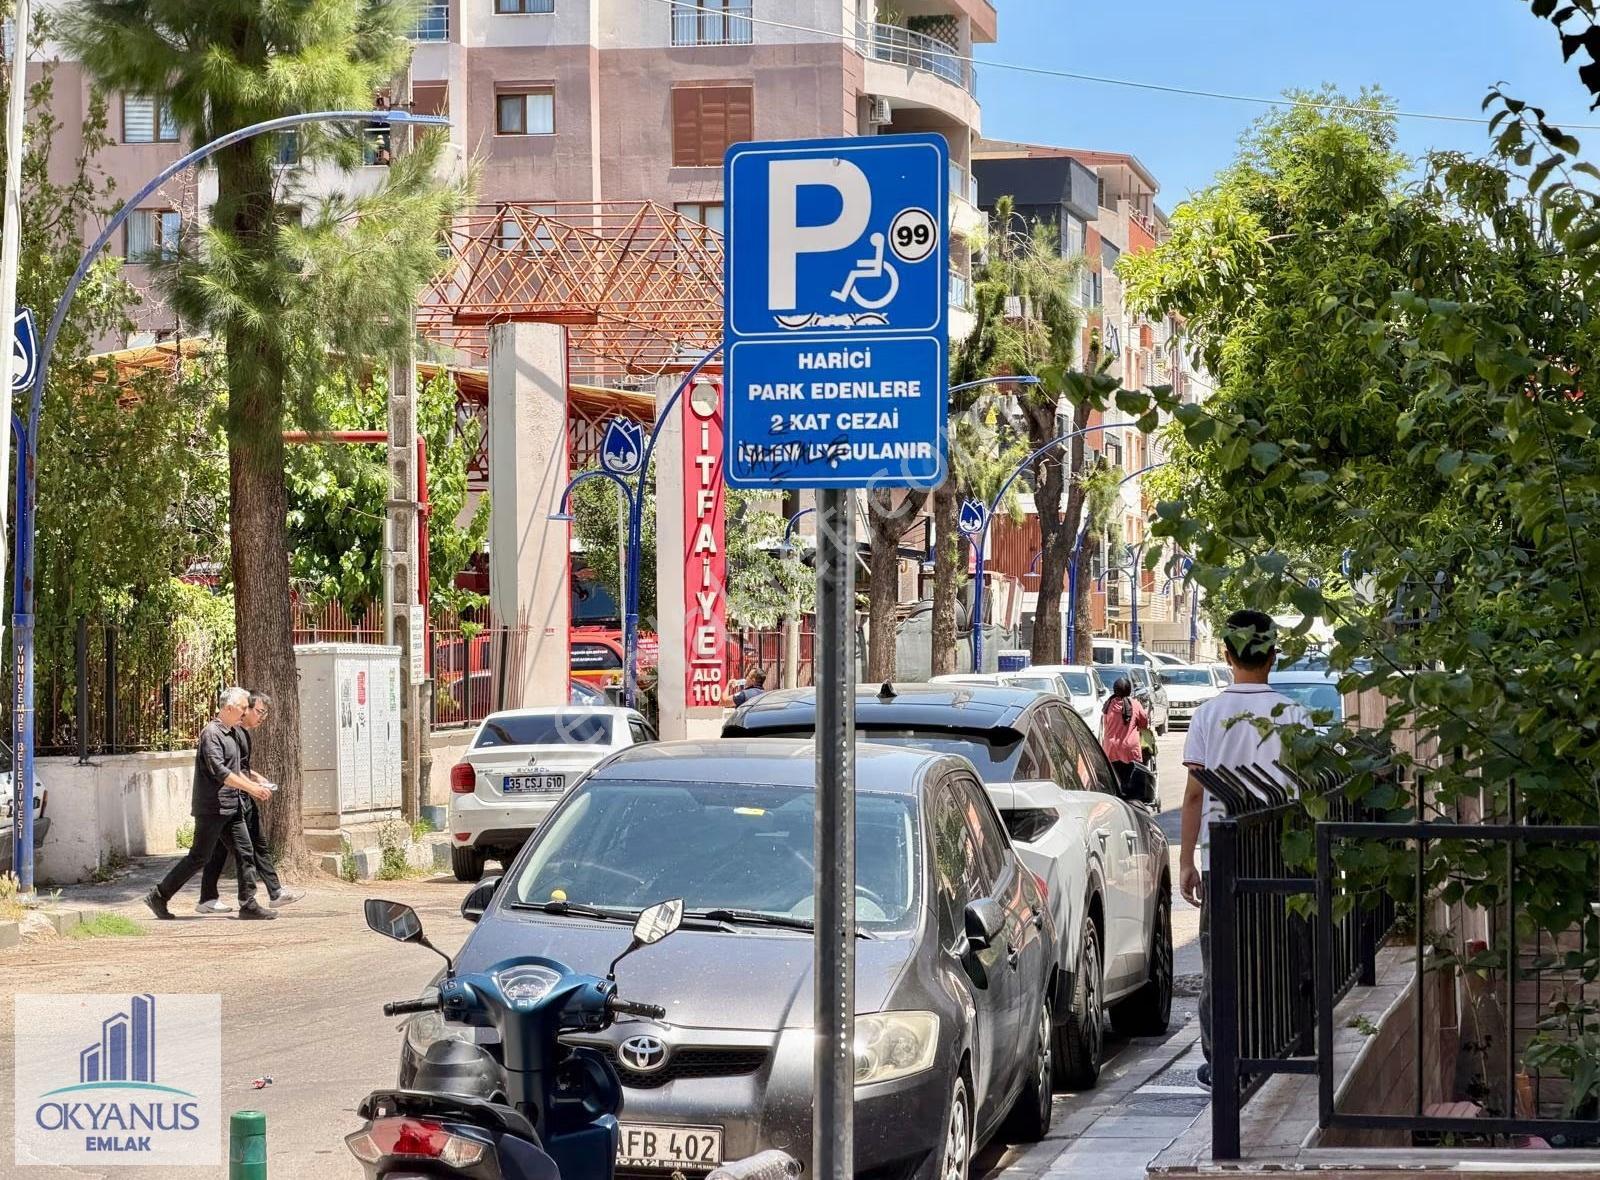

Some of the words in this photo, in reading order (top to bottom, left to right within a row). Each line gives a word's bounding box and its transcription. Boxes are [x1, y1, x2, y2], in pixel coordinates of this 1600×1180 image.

[768, 158, 872, 310] P
[897, 225, 930, 247] 99
[798, 347, 872, 369] HARİCİ
[748, 383, 805, 401] PARK
[811, 381, 921, 400] EDENLERE
[770, 415, 784, 431] 2
[790, 413, 831, 431] KAT
[836, 408, 899, 430] CEZAİ
[808, 442, 931, 460] UYGULANIR
[693, 668, 721, 682] ALO
[17, 645, 25, 732] YUNUSEMRE
[693, 684, 722, 702] 110
[509, 778, 521, 789] 35
[525, 778, 542, 788] CSJ
[546, 777, 562, 788] 610
[669, 1133, 715, 1162] 402
